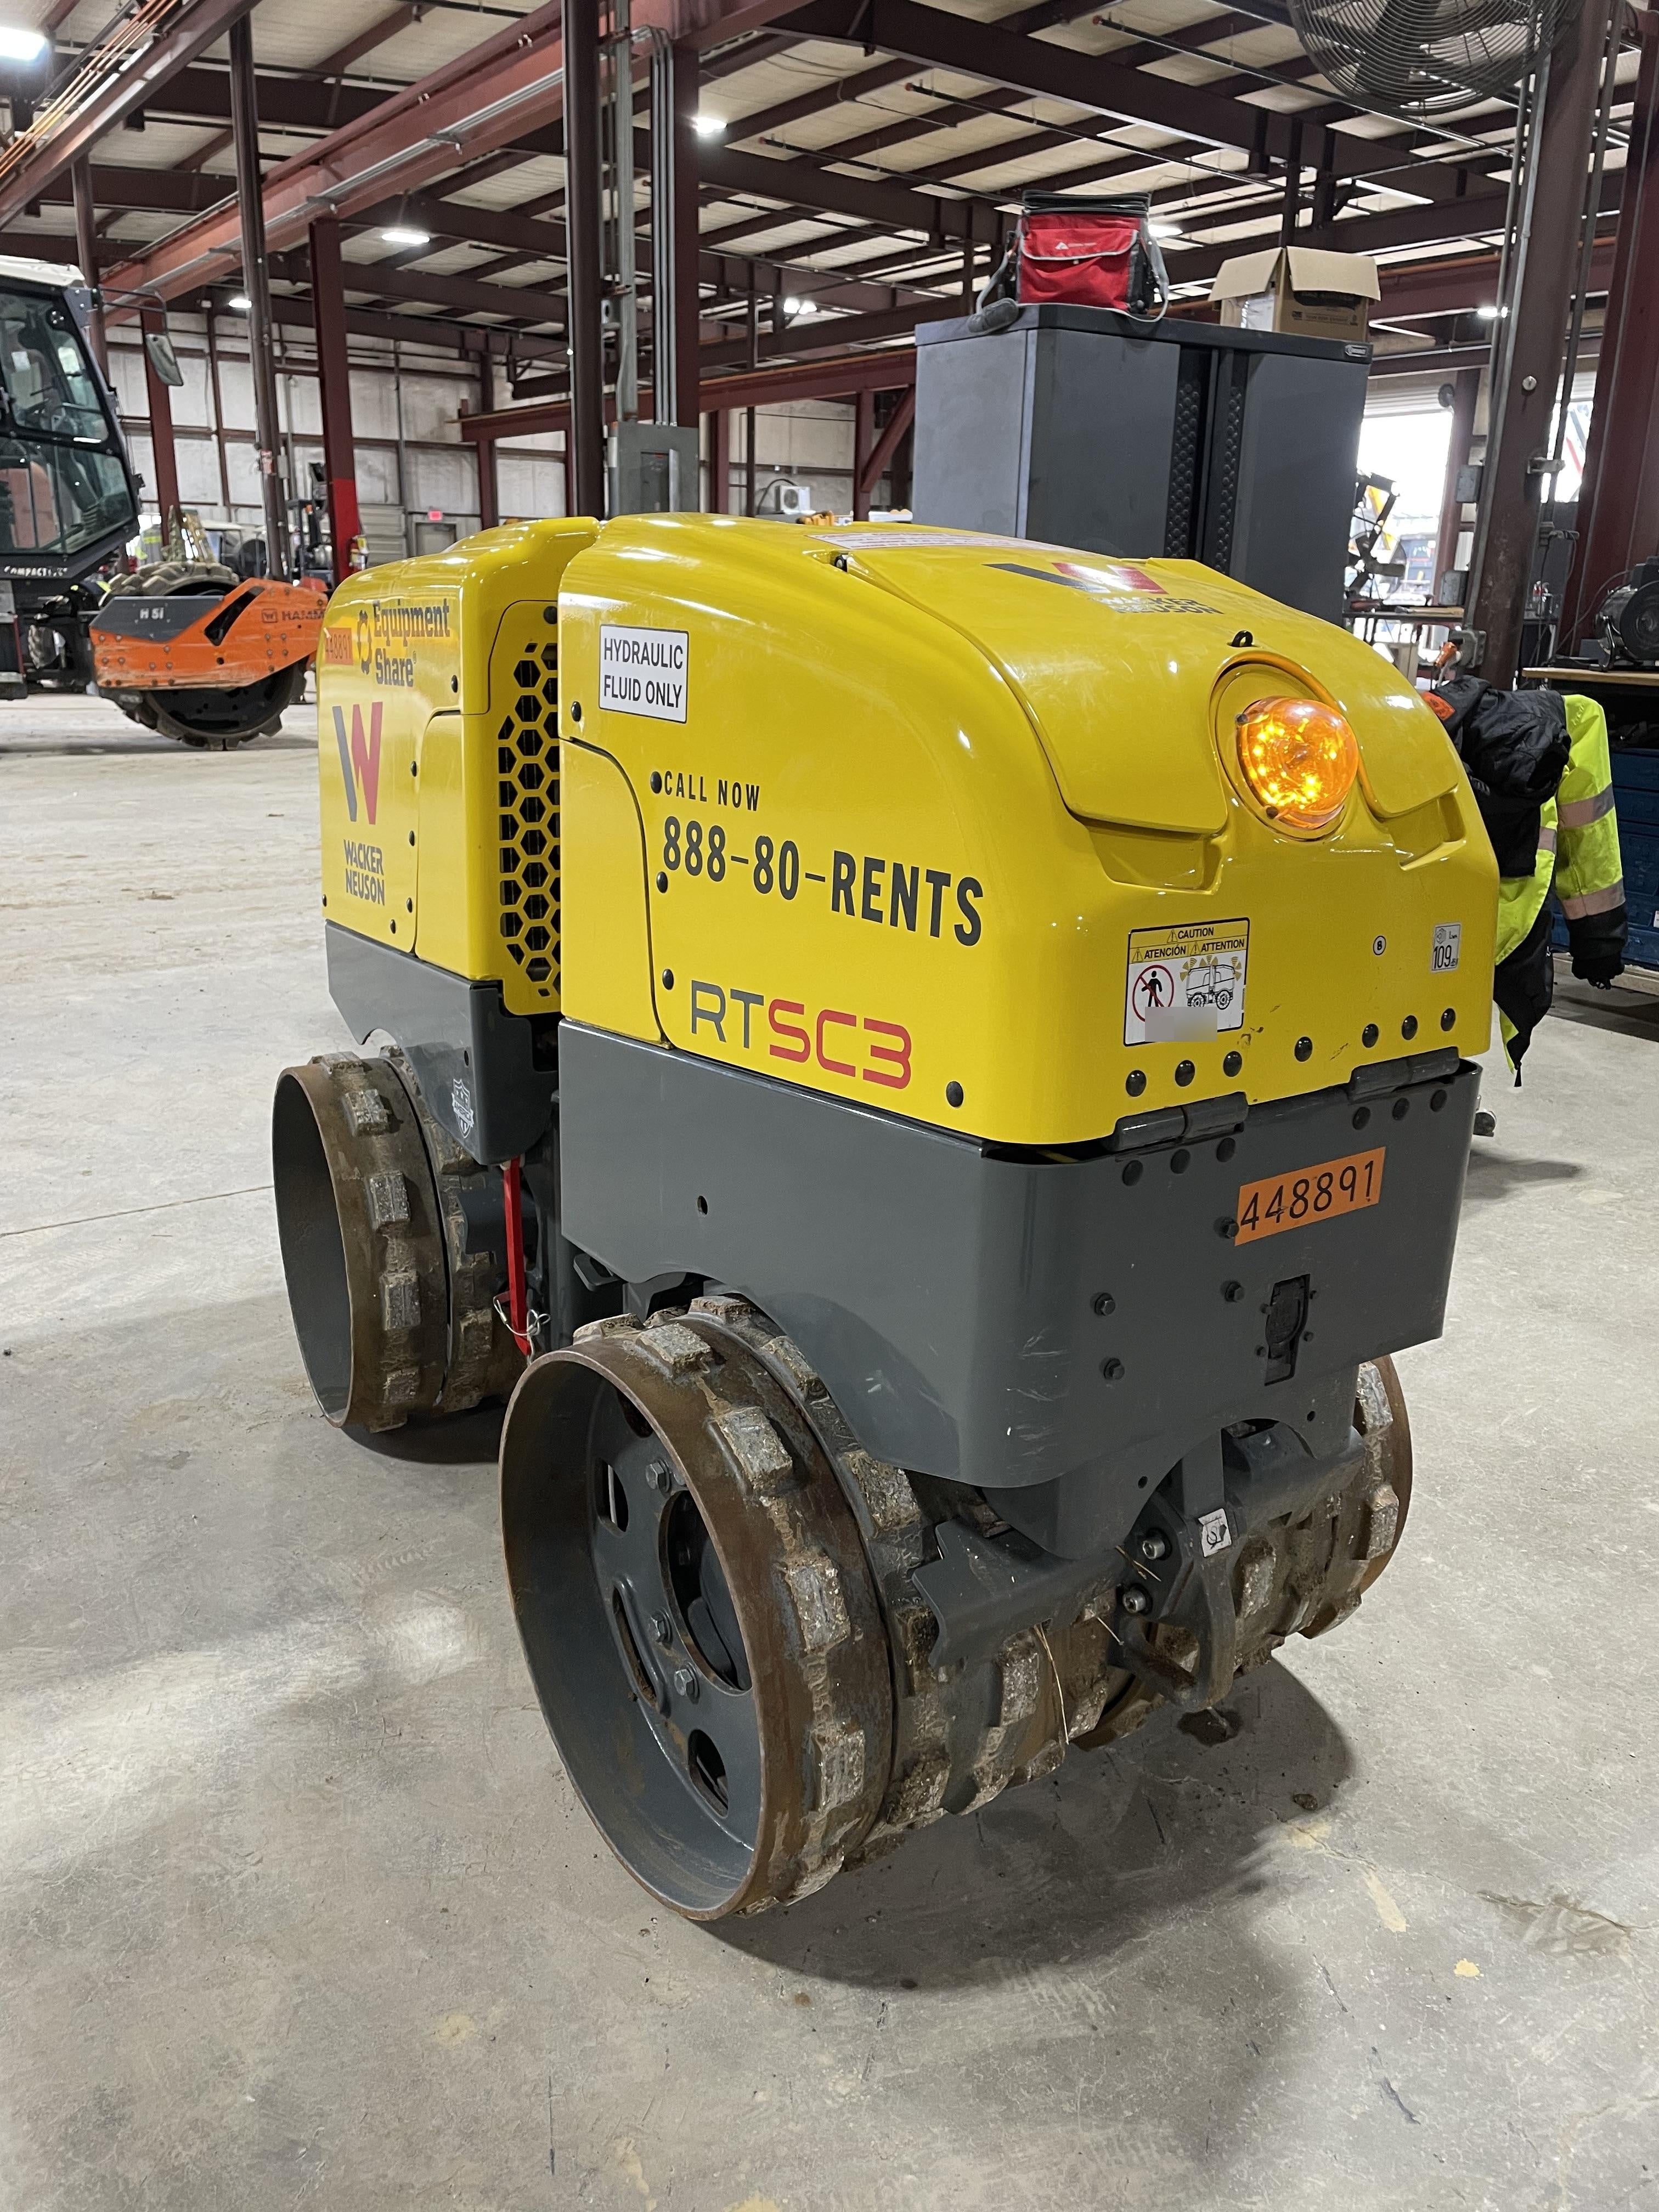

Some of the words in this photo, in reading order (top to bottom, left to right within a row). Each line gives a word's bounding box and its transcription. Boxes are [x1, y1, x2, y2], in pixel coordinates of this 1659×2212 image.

[373, 598, 450, 647] Equipment
[604, 637, 684, 670] HYDRAULIC
[604, 674, 641, 702] FLUID
[645, 680, 682, 708] ONLY
[664, 770, 707, 802] CALL
[718, 779, 760, 812] NOW
[343, 839, 384, 876] WACKER
[345, 868, 385, 906] NEUSON
[663, 816, 984, 947] 888-80-RENTS
[1144, 944, 1187, 960] ATENCIÓN
[1200, 939, 1245, 952] ATTENTION
[1177, 927, 1214, 939] CAUTION
[1434, 945, 1452, 969] 109
[691, 979, 912, 1090] RTSC3
[1240, 1160, 1374, 1231] 448891
